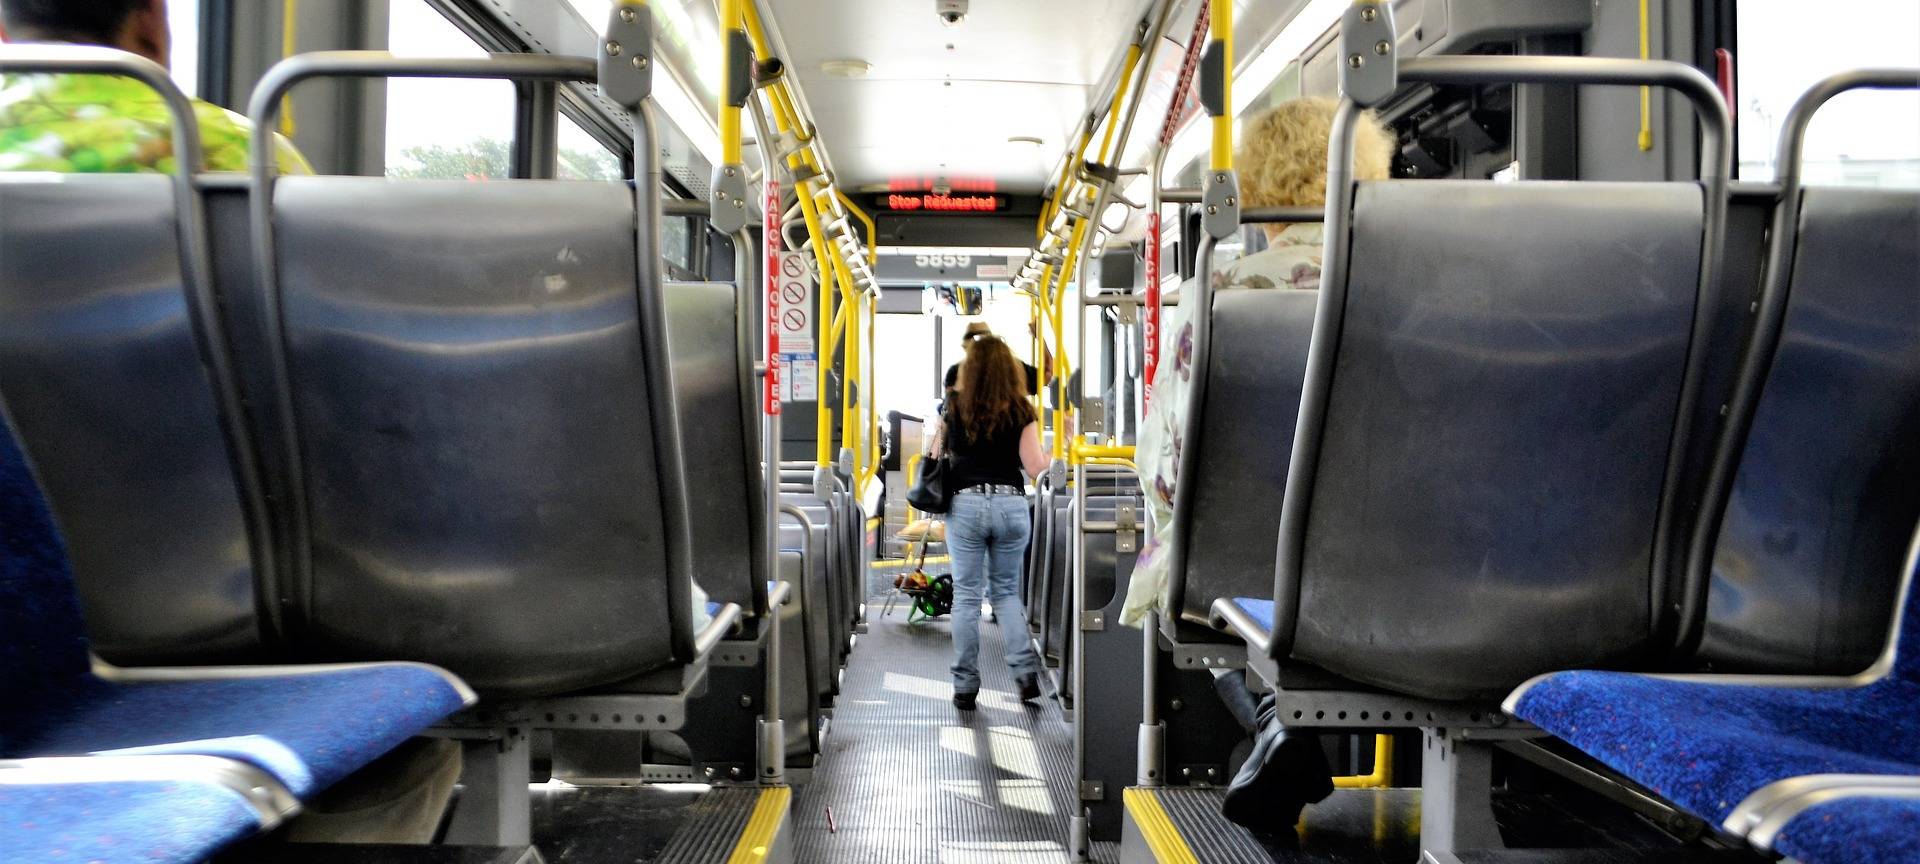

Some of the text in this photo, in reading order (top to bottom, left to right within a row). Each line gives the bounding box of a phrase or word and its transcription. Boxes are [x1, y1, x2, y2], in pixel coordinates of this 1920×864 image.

[888, 194, 996, 211] Stop Requested
[915, 254, 970, 267] 5859
[1146, 212, 1155, 289] WATCH
[768, 183, 780, 413] WATCH YOUR STEP
[1145, 306, 1154, 367] YOUR
